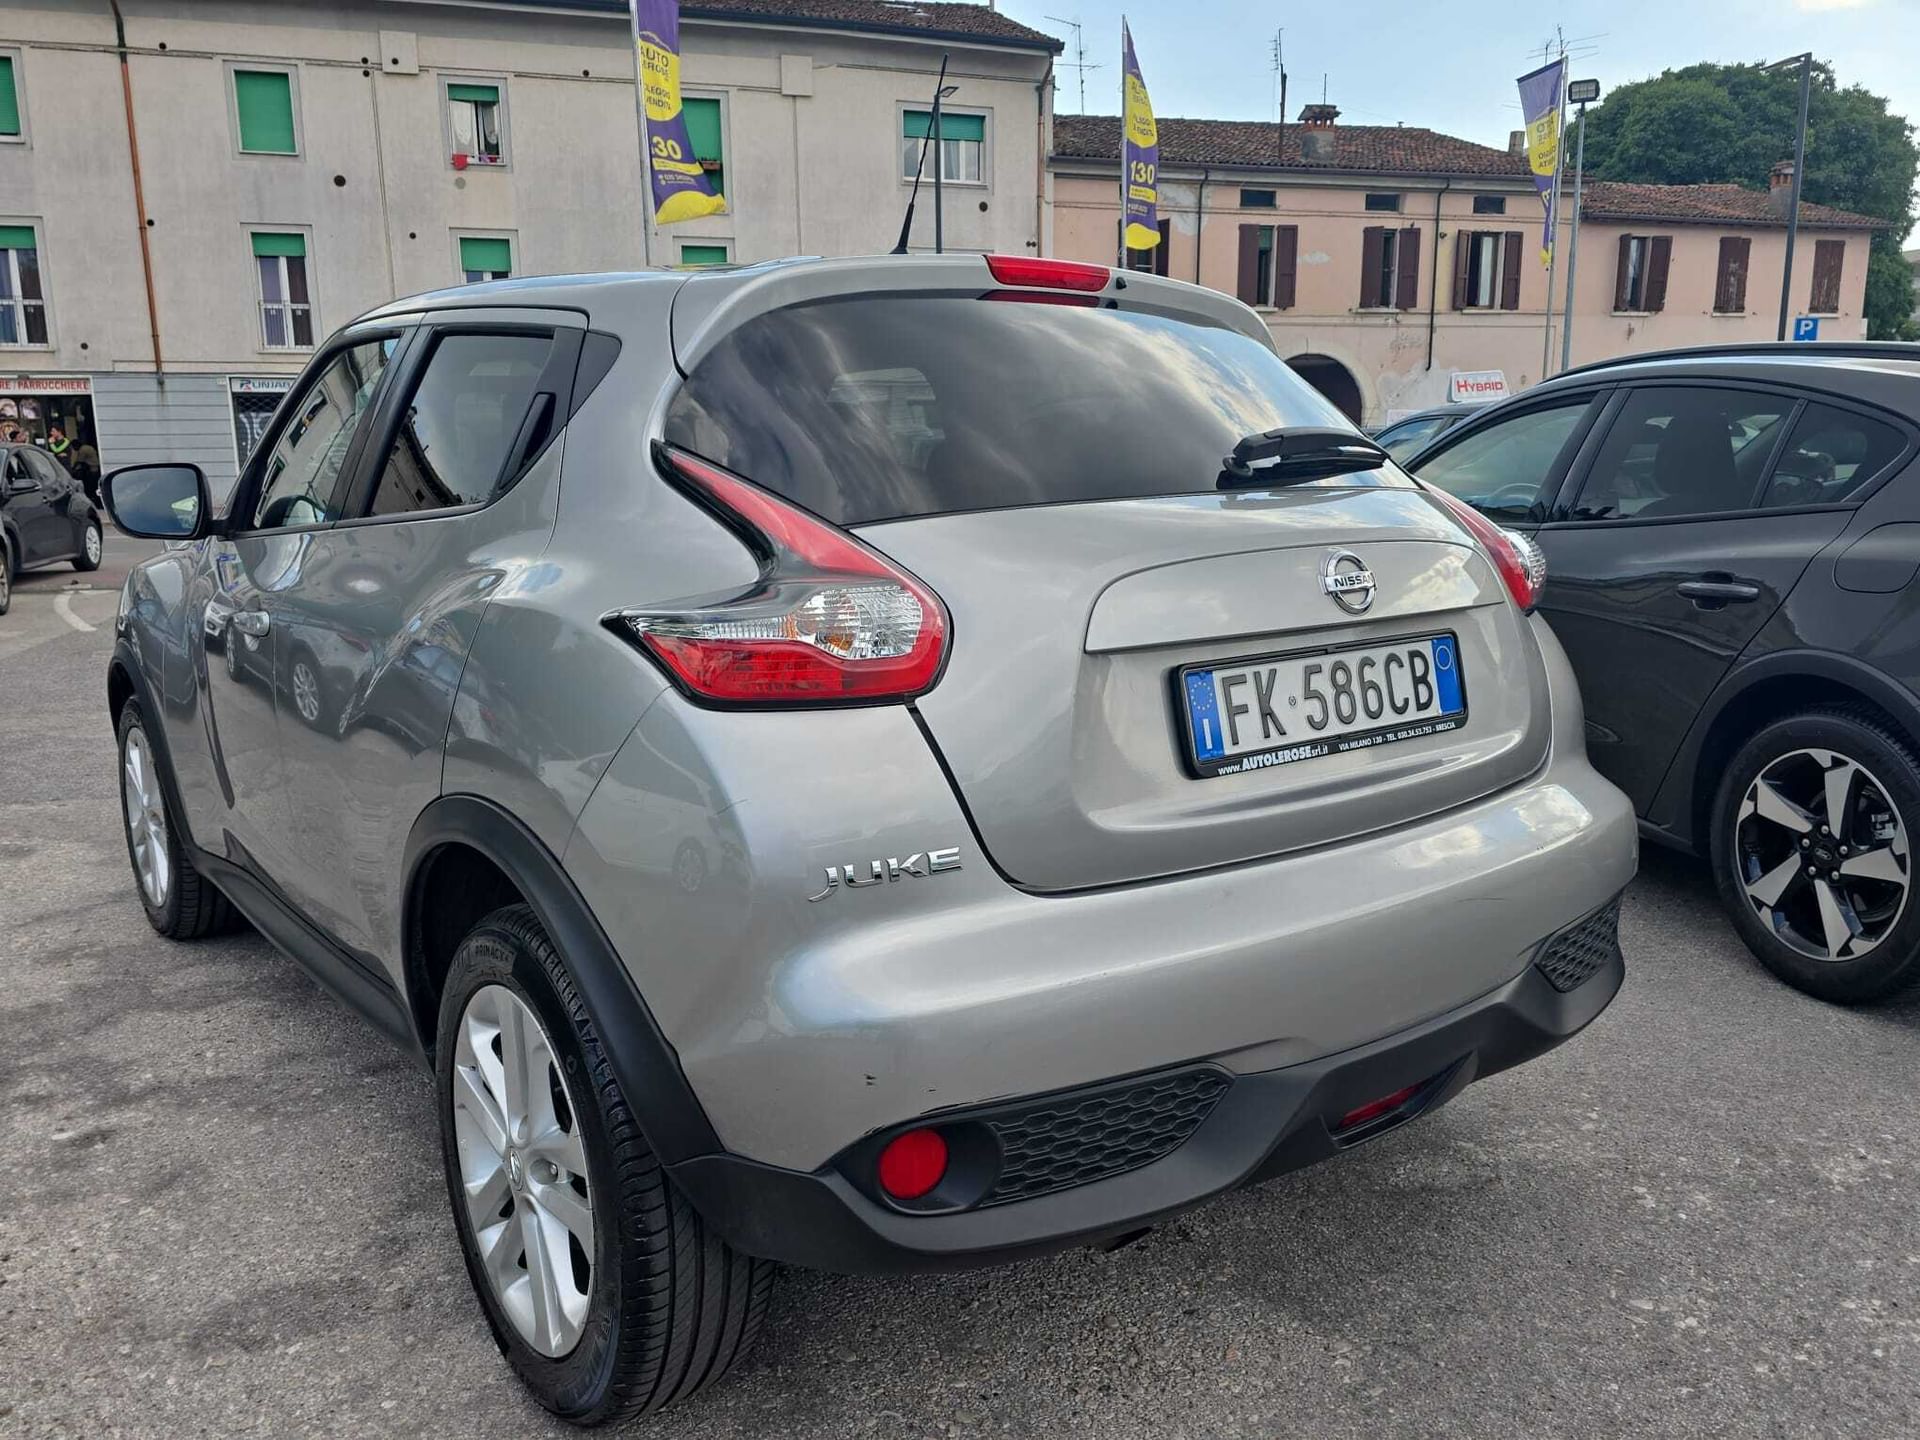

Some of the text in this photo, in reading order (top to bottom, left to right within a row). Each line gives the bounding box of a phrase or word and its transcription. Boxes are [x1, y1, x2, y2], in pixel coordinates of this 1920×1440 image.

[1131, 160, 1155, 185] 130
[1800, 320, 1814, 335] P
[1456, 379, 1503, 393] HYBRID
[1333, 571, 1374, 588] NISSAN
[1221, 650, 1433, 746] FK 586CB
[1339, 743, 1349, 752] VIA
[1349, 737, 1372, 749] MILANO
[808, 847, 964, 902] JUKE
